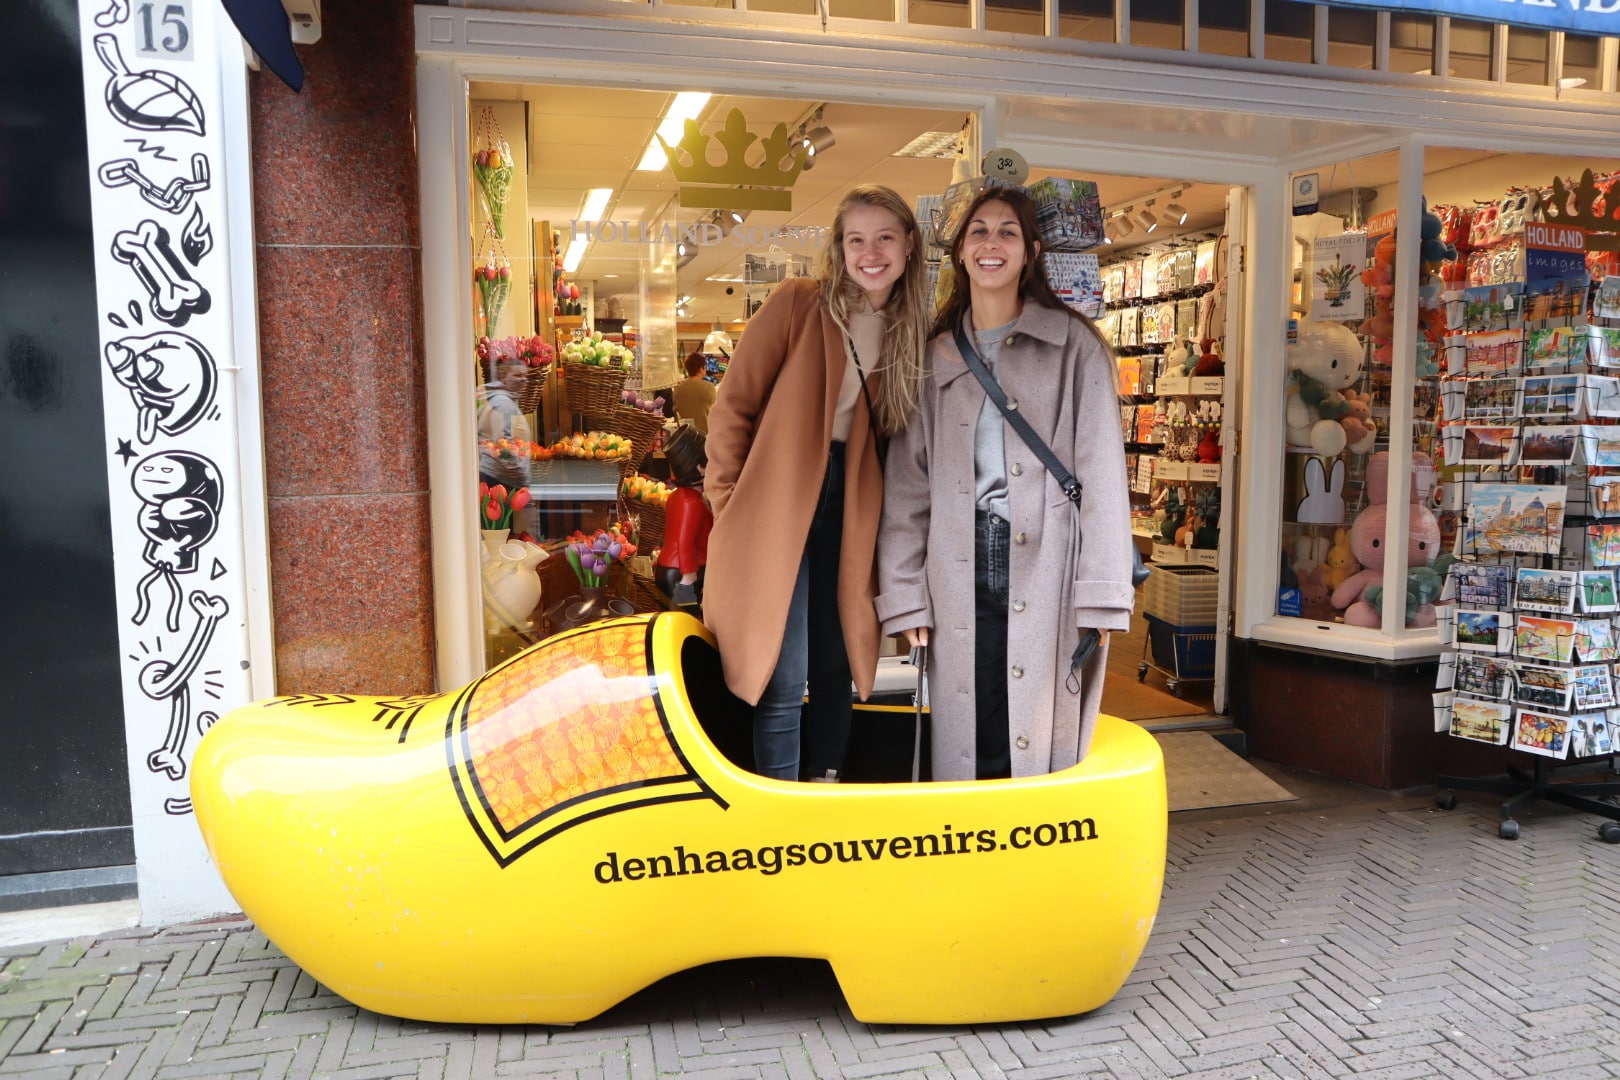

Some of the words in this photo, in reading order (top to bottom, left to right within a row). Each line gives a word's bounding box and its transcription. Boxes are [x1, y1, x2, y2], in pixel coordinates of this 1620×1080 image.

[137, 3, 188, 52] 15
[569, 219, 724, 246] HOLLAND
[1527, 226, 1584, 249] HOLLAND
[1528, 252, 1584, 273] images
[594, 816, 1098, 884] denhaagsouvenirs.com
